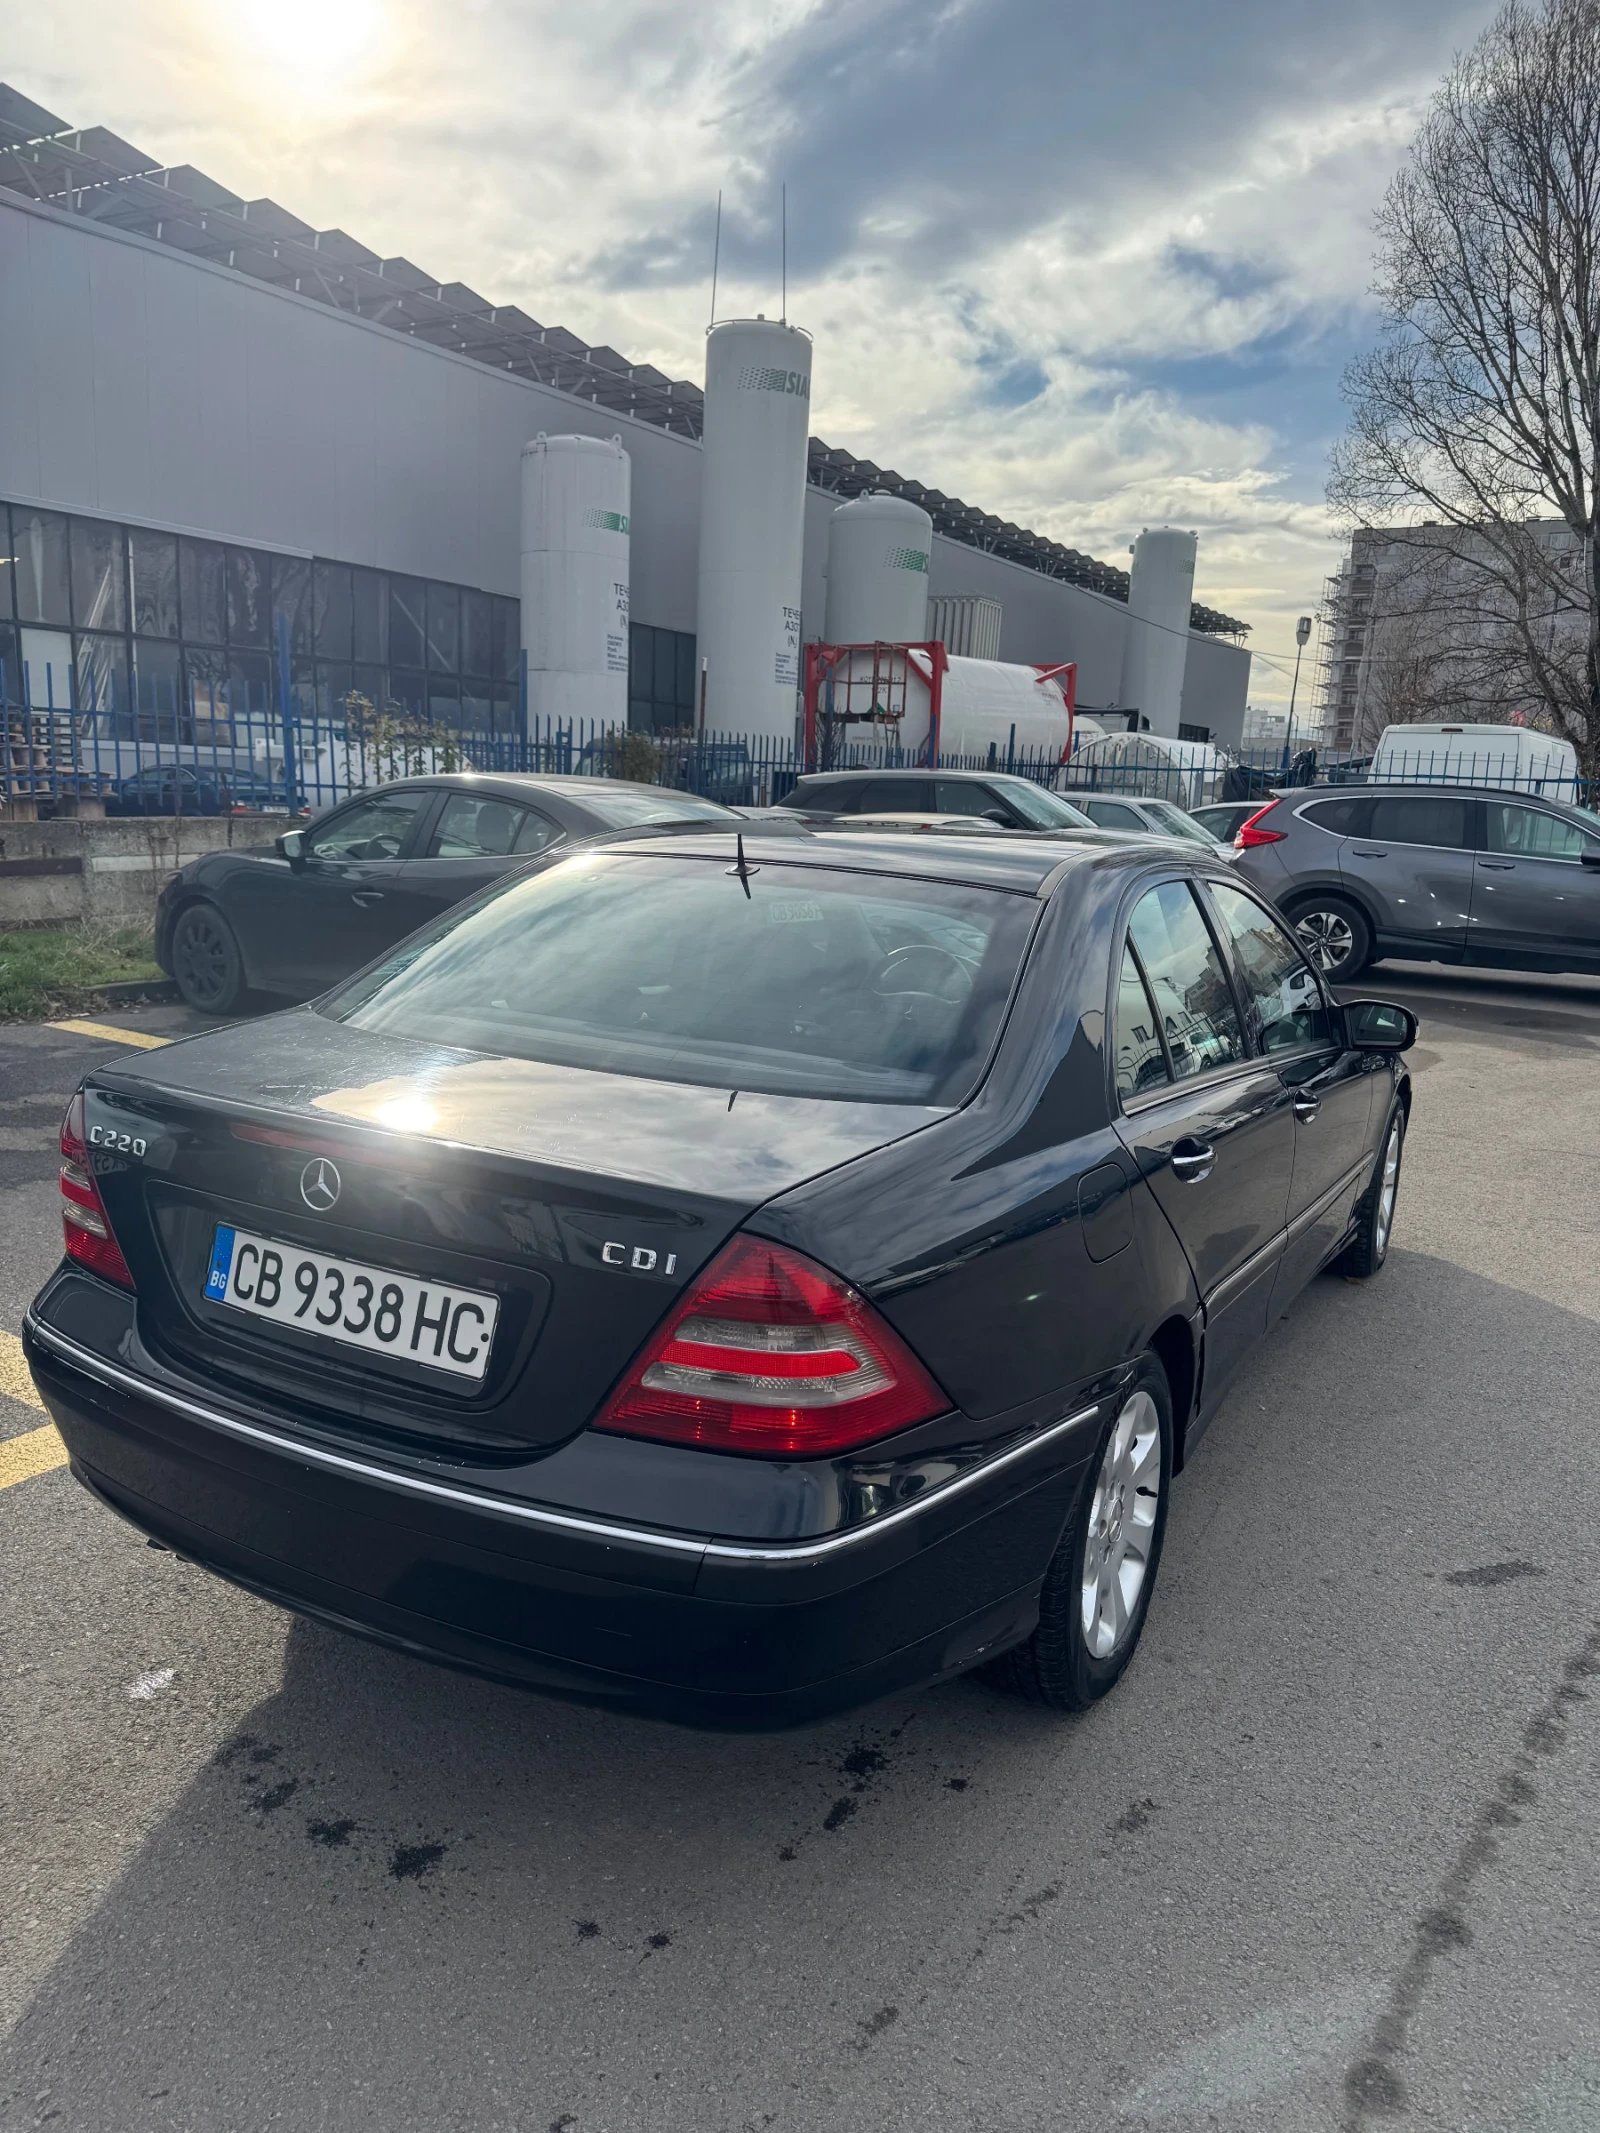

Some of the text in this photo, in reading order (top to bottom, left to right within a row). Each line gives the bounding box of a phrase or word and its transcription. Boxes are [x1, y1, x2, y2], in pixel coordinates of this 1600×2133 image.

[786, 371, 809, 400] SIA
[90, 1125, 147, 1157] C220
[602, 1241, 677, 1275] CDI
[210, 1270, 227, 1290] BG
[233, 1243, 485, 1364] CB 9338 HC
